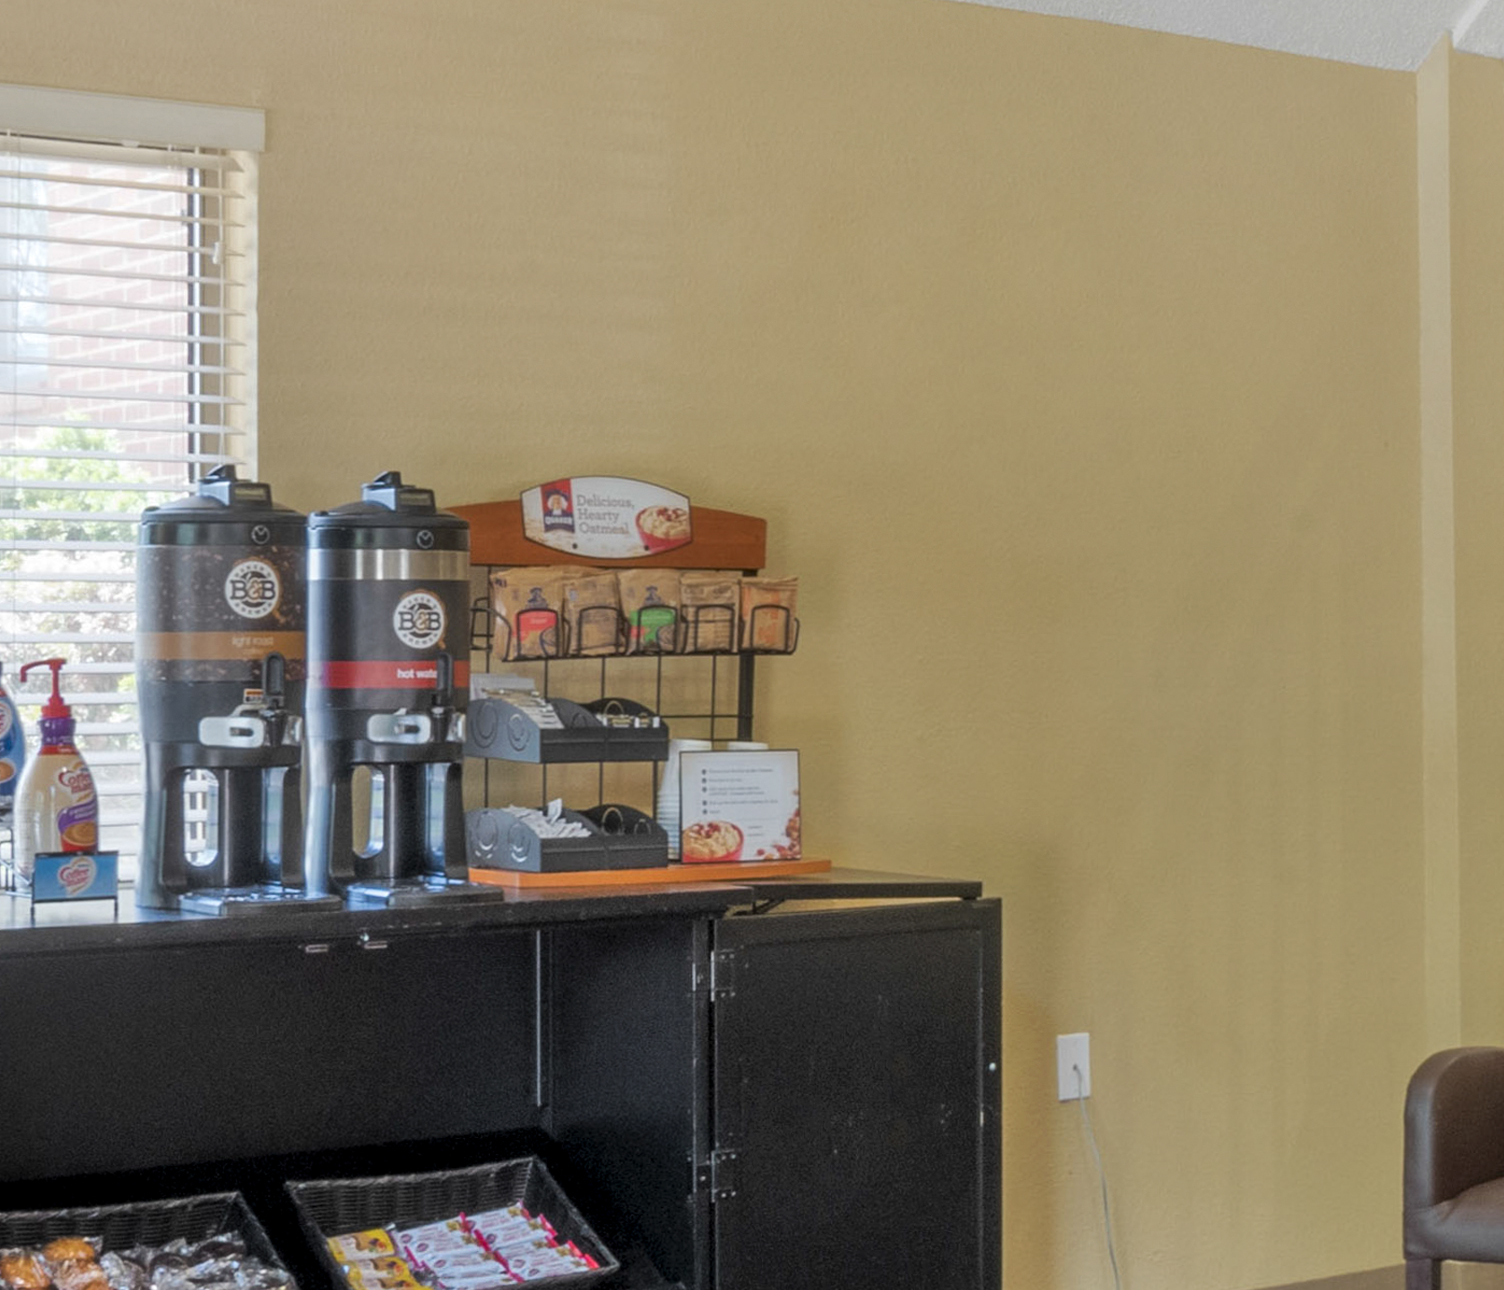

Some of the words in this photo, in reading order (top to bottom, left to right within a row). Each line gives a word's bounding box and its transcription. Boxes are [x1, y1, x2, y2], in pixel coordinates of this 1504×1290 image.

[576, 494, 635, 510] Delicious,
[578, 508, 620, 523] Hearty
[579, 522, 629, 535] Oatmeal
[230, 579, 276, 601] B&B
[398, 611, 441, 632] B&B
[397, 668, 415, 679] hot
[416, 668, 438, 679] wate
